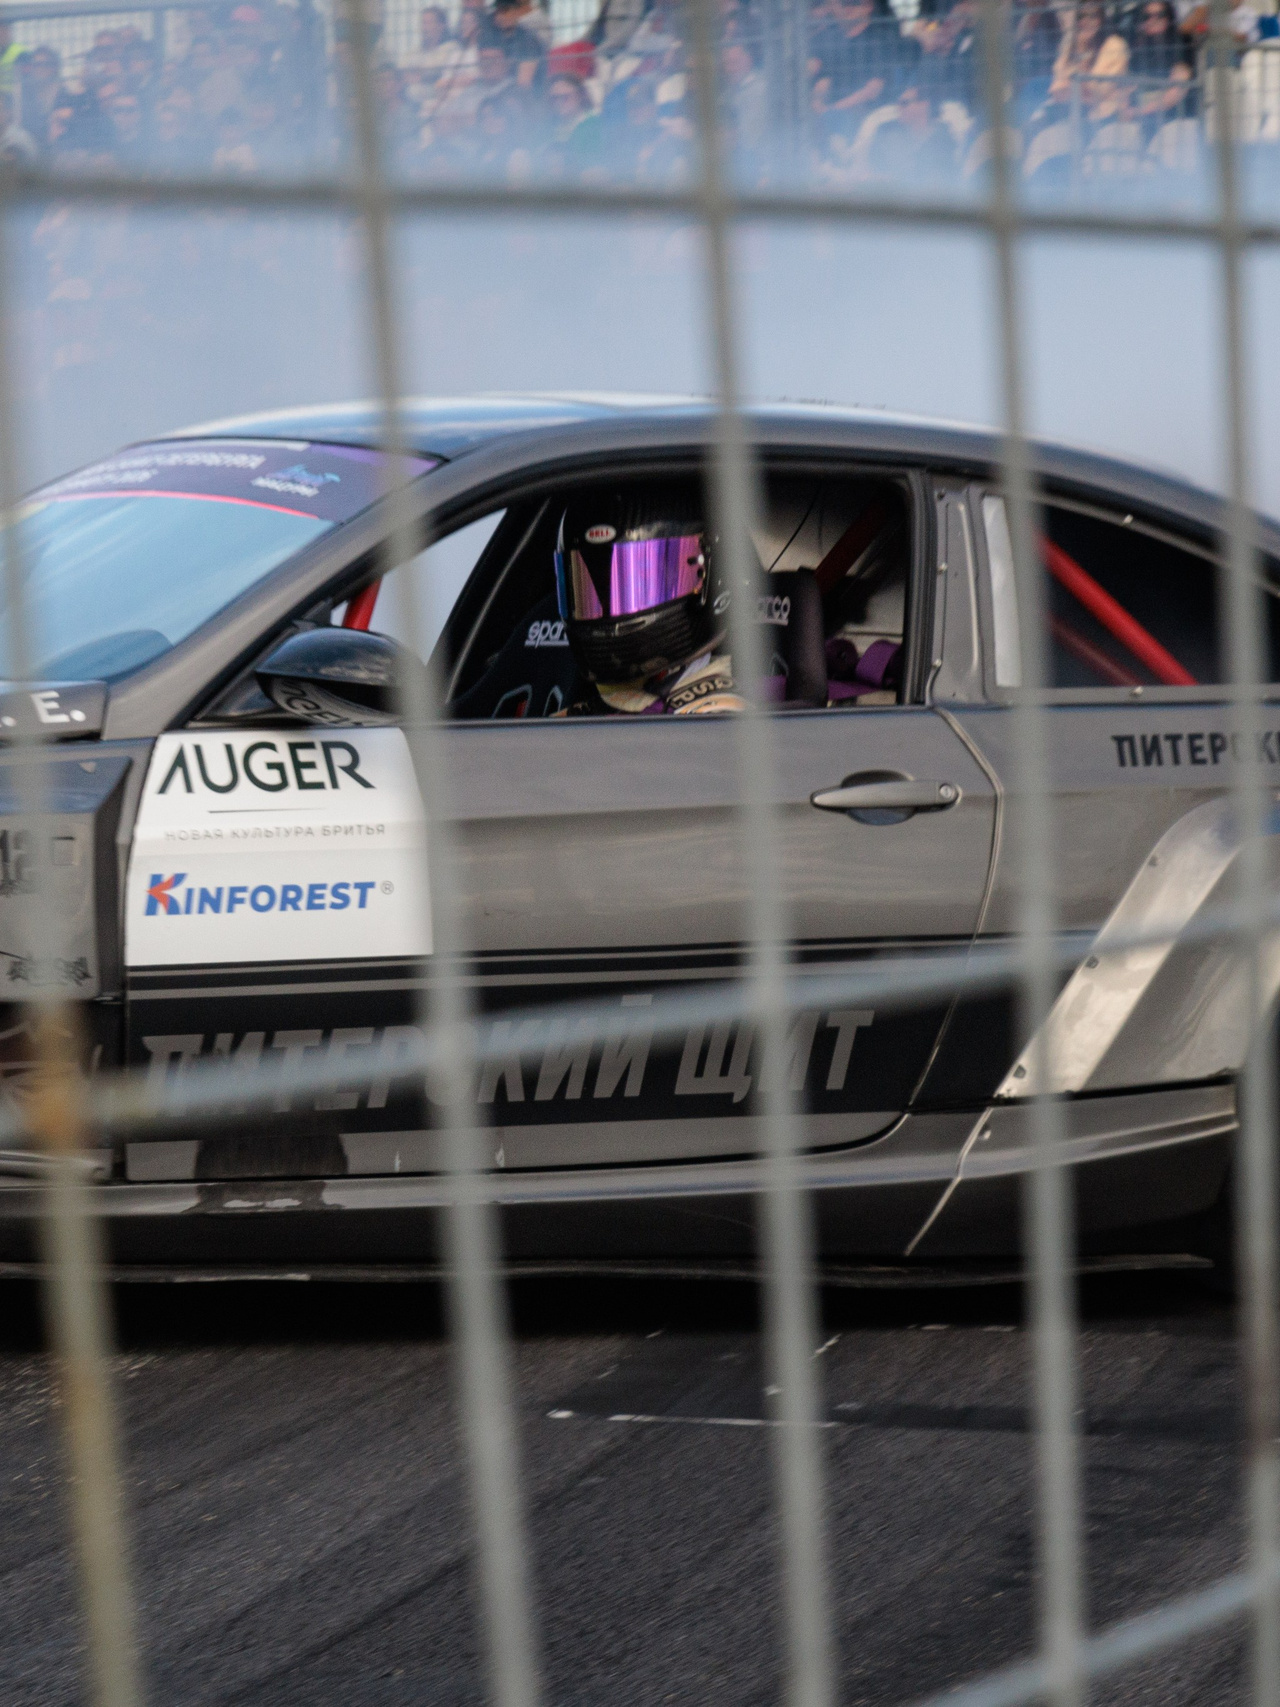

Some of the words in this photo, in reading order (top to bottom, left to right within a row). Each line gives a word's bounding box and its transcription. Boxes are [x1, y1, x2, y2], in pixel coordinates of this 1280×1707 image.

[30, 689, 87, 725] E.
[156, 740, 377, 795] AUGER
[164, 828, 224, 842] НОВАЯ
[230, 825, 315, 840] КУЛЬТУРА
[321, 823, 386, 838] БРИТЬЯ
[143, 872, 377, 917] KINFOREST
